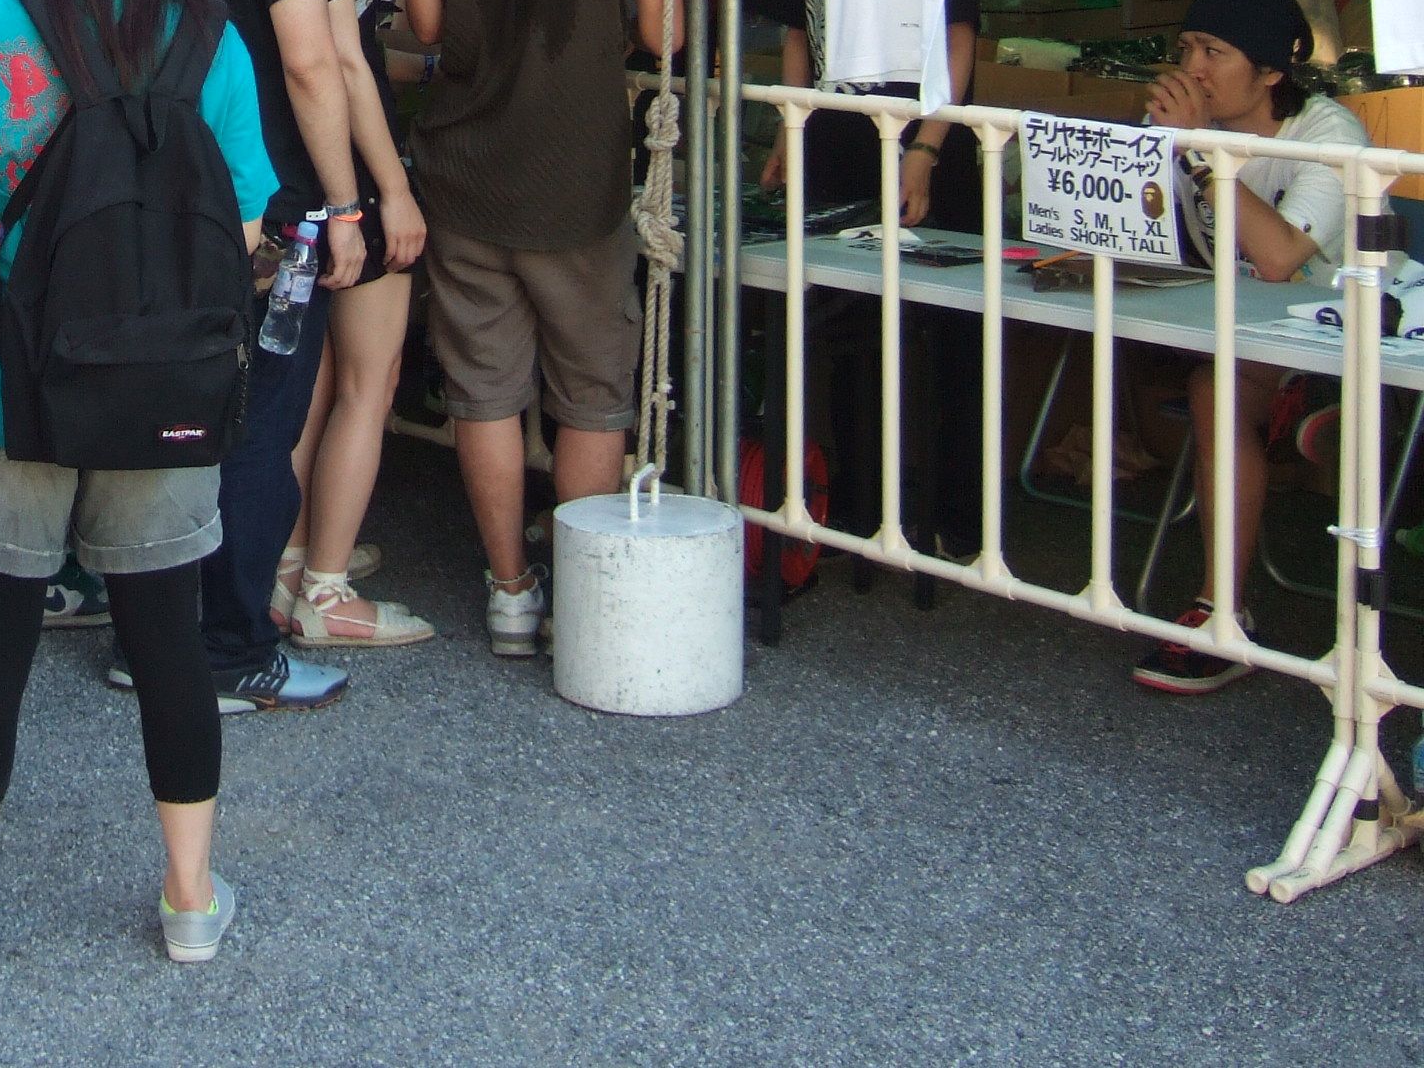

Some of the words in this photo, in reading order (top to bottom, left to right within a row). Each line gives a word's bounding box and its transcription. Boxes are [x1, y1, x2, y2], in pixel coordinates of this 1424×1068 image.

[1026, 118, 1167, 159] テリヤキボーイズ
[1028, 142, 1161, 178] ワールドツアーTシャツ
[1048, 167, 1133, 203] ¥6,000-
[1028, 203, 1060, 221] Men's
[1145, 220, 1168, 238] XL
[1028, 220, 1064, 239] Ladies
[1128, 236, 1171, 255] TALL
[162, 429, 205, 437] EASTPAK
